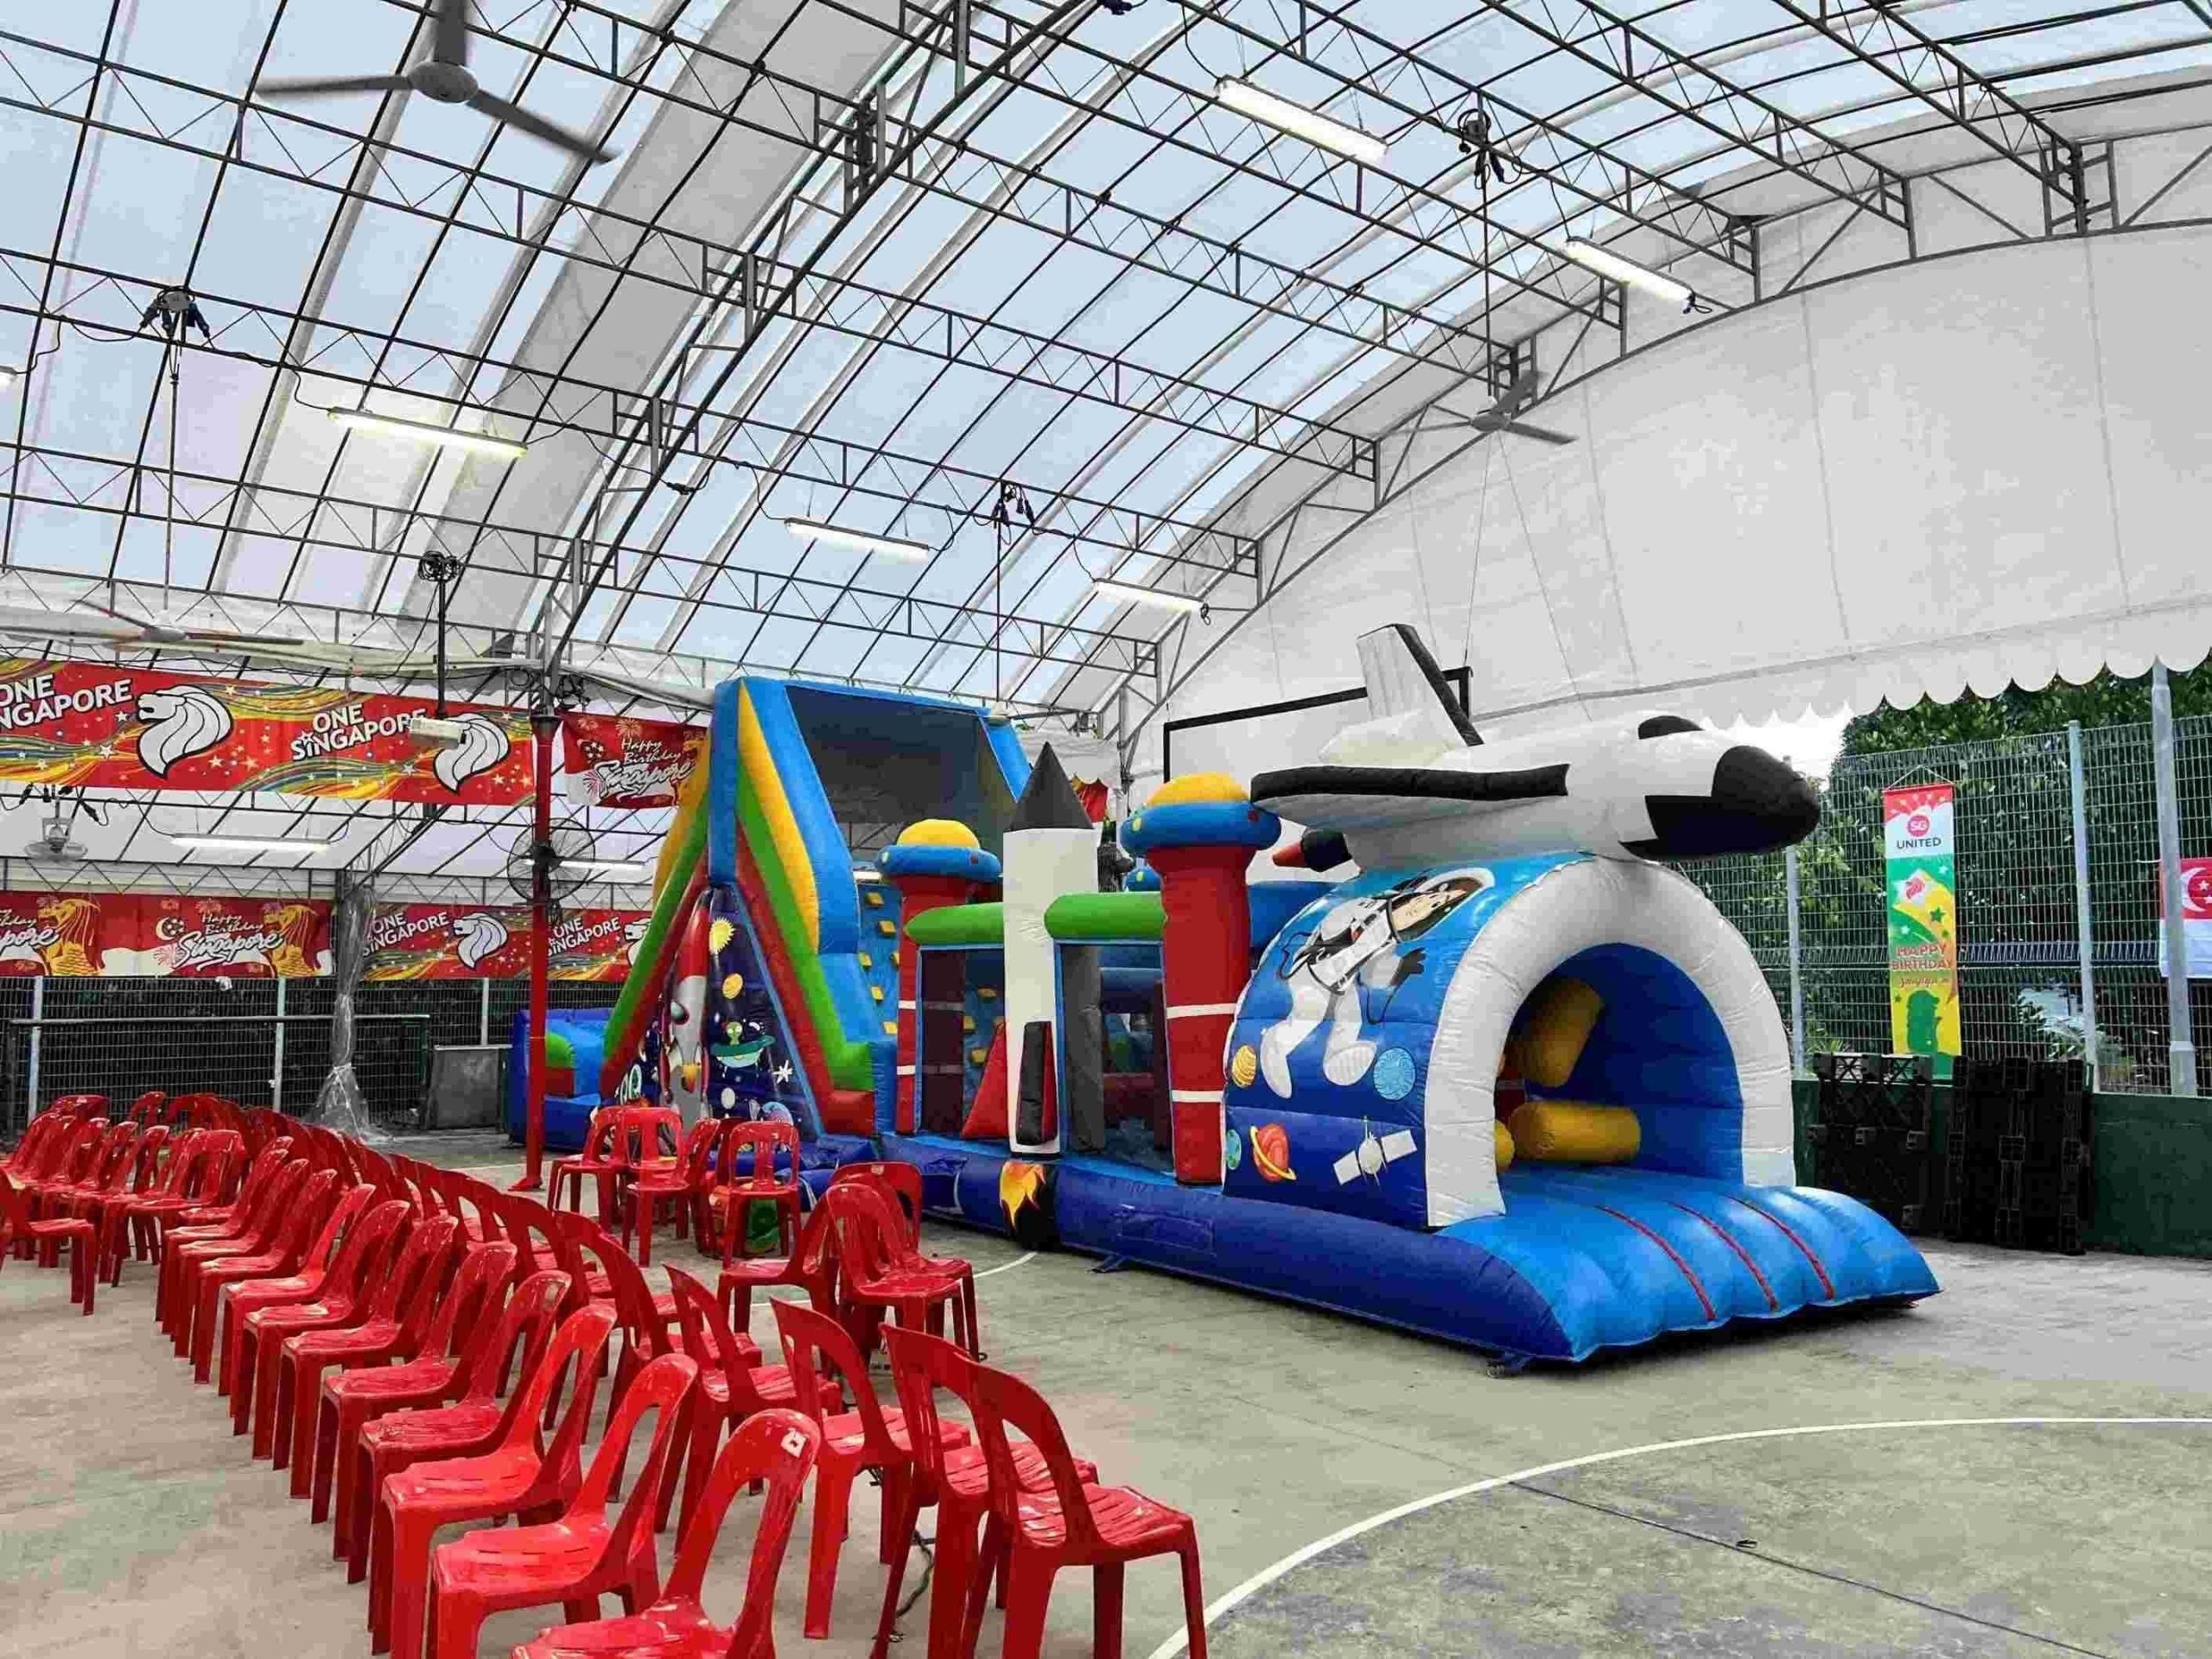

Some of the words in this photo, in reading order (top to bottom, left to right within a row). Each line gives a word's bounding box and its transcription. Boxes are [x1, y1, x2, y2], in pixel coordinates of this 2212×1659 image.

[0, 674, 54, 707] ONE
[313, 704, 364, 733] ONE
[621, 738, 663, 753] Happy
[623, 747, 681, 765] Birthday
[594, 760, 696, 803] Singapore
[1897, 837, 1942, 849] UNITED
[202, 913, 242, 924] Happy
[205, 922, 264, 934] Birthday
[372, 912, 406, 933] ONE
[554, 918, 583, 938] ONE
[173, 931, 283, 971] Singapore
